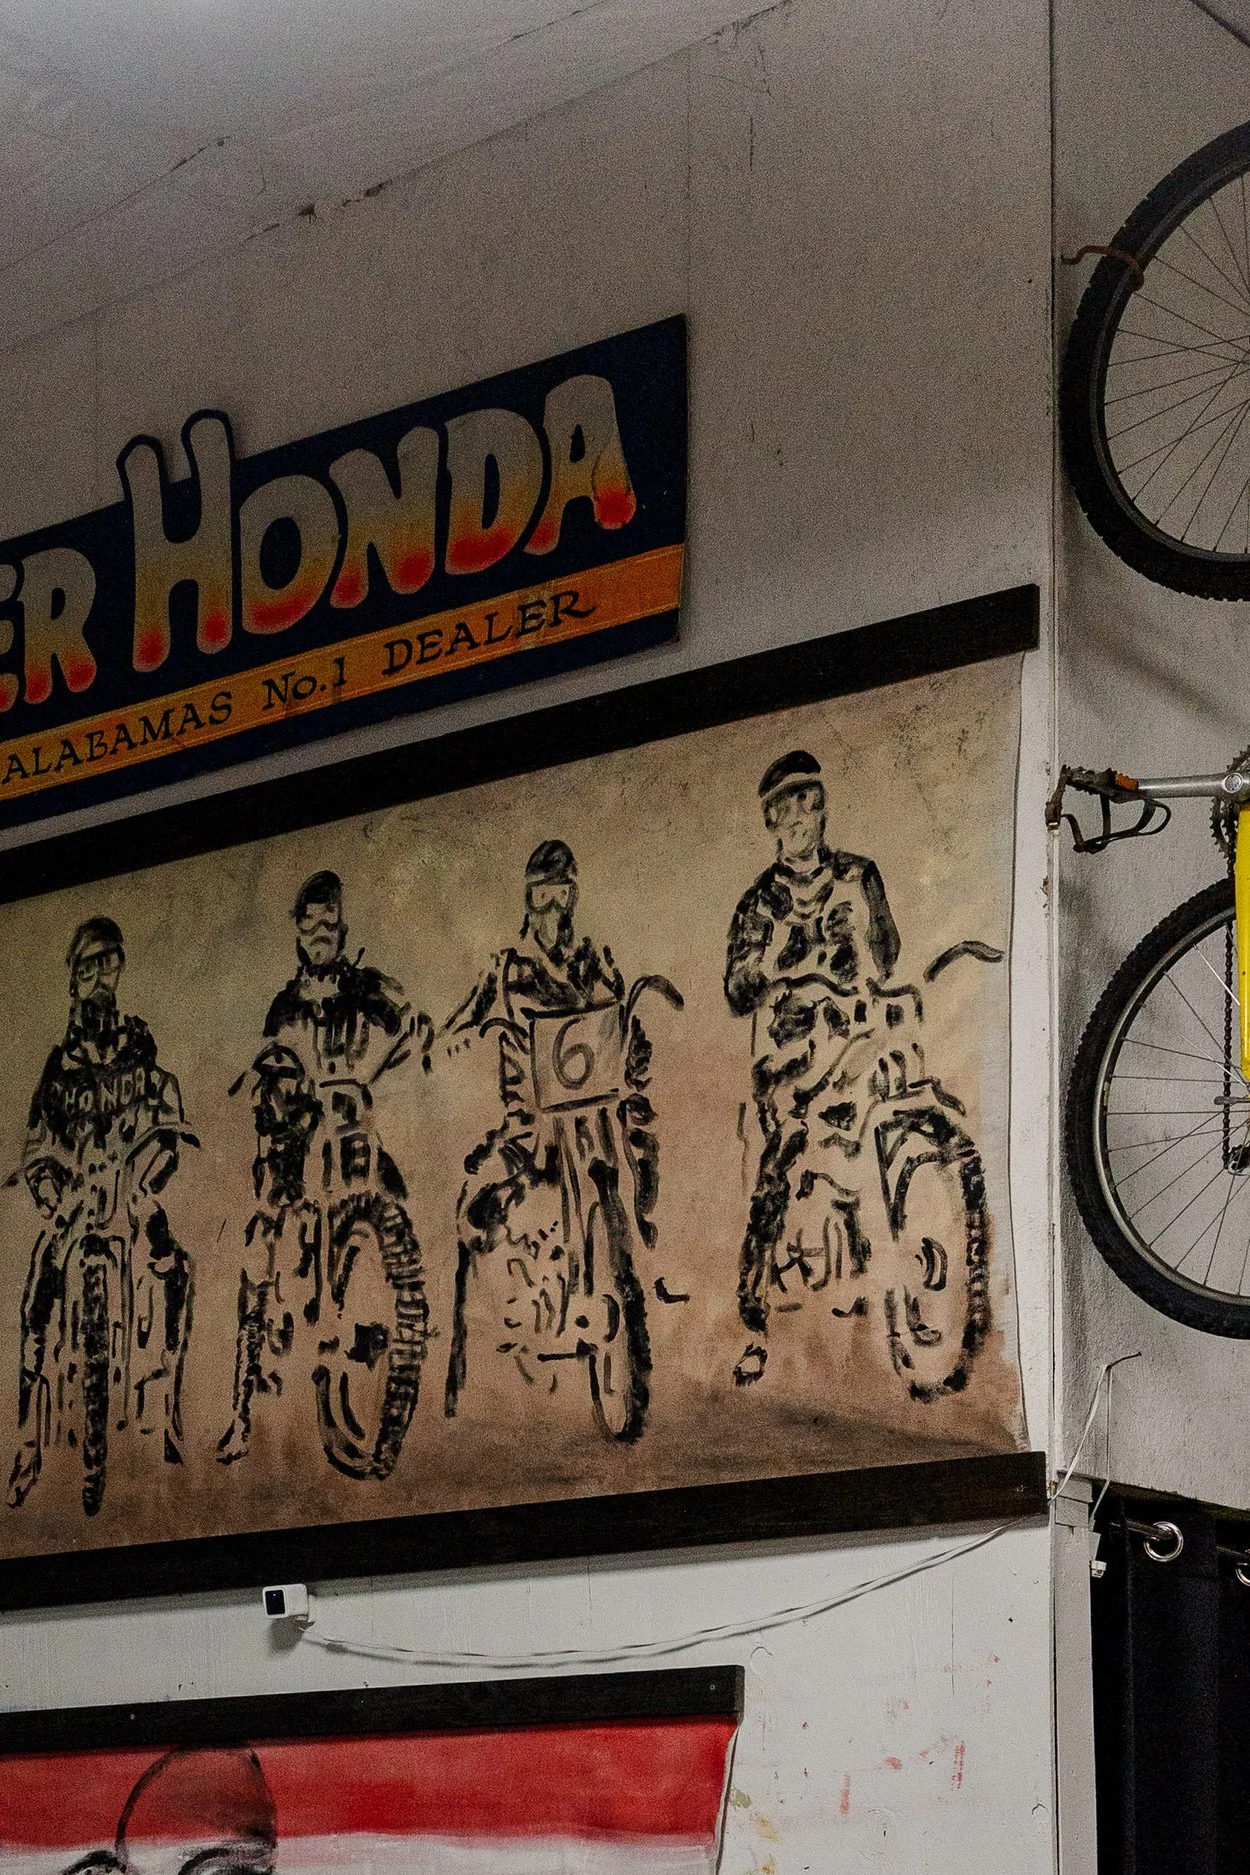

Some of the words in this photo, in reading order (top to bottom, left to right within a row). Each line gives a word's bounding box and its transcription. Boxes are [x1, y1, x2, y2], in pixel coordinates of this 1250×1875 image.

[123, 374, 637, 672] HONDA
[0, 690, 234, 786] ALABAMAS
[262, 656, 348, 711] No.1
[381, 590, 597, 677] DEALER
[64, 1065, 147, 1113] HONDA
[552, 1017, 595, 1091] 6
